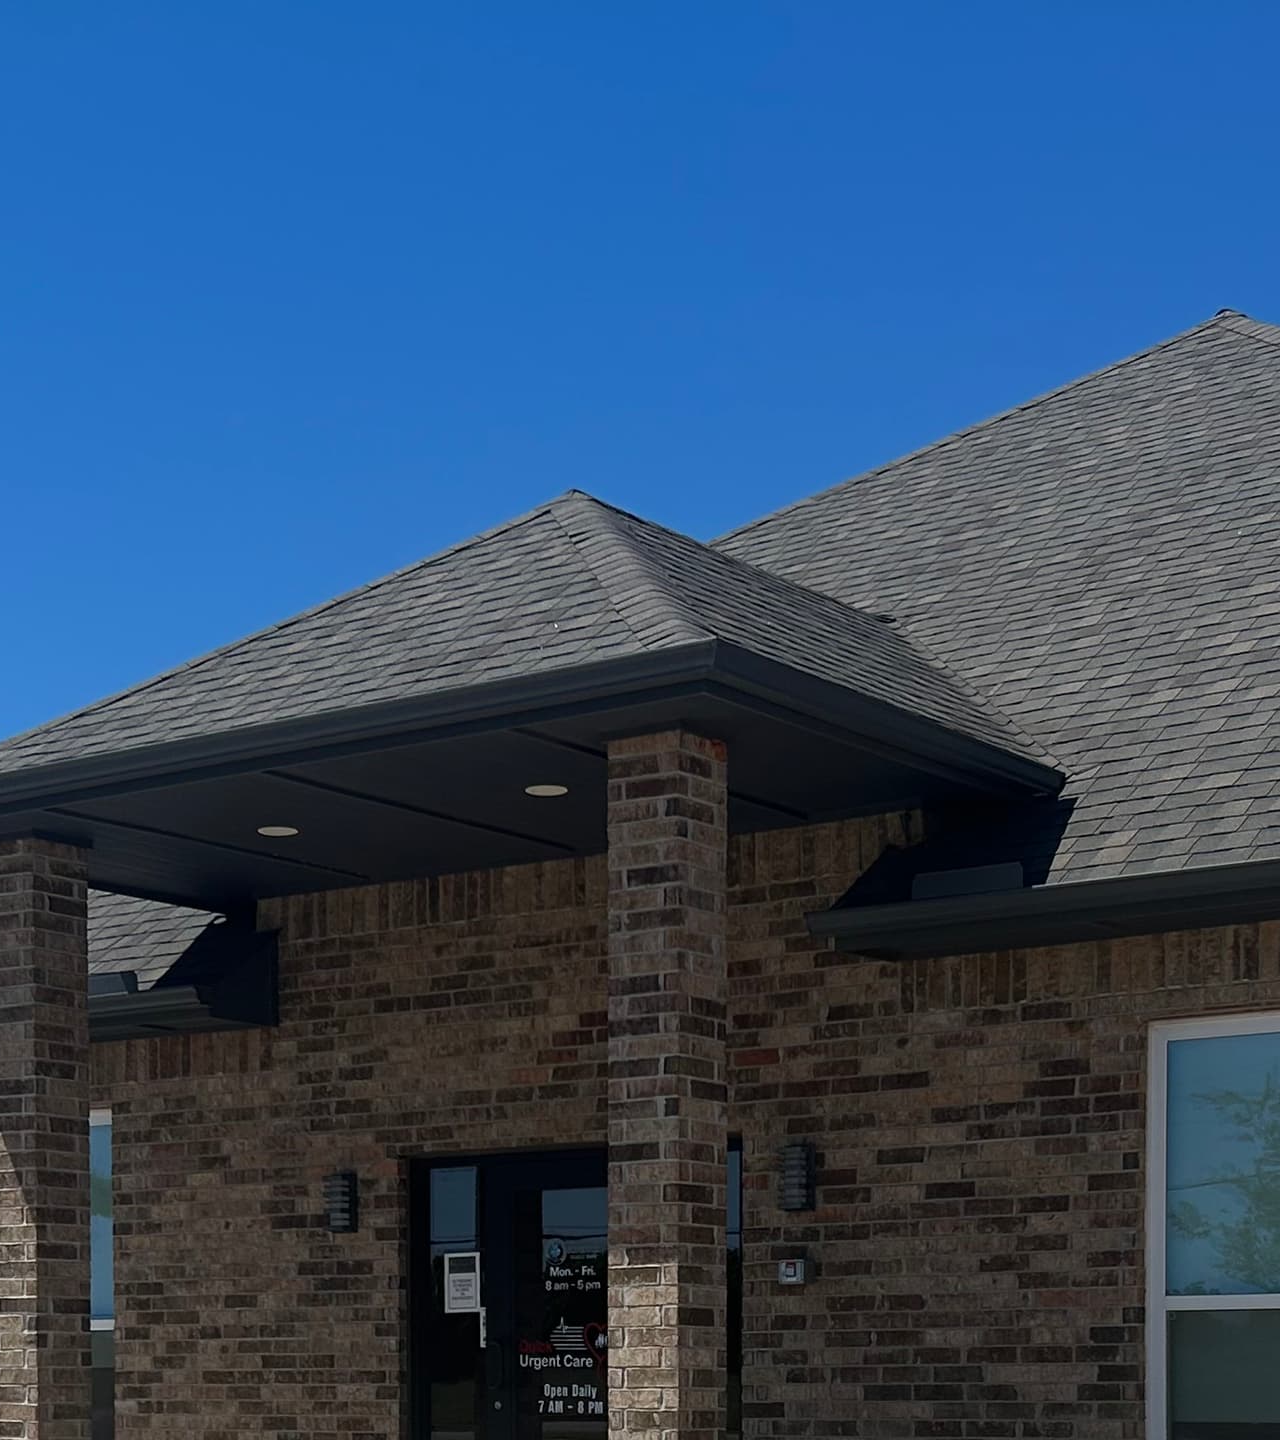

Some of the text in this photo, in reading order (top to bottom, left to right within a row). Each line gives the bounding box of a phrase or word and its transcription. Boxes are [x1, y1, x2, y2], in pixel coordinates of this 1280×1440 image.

[550, 1266, 573, 1277] Mon.
[582, 1265, 597, 1276] Fri.
[545, 1280, 552, 1291] 8
[553, 1282, 569, 1290] am
[577, 1280, 584, 1290] 5
[585, 1281, 601, 1292] pm
[519, 1354, 593, 1370] Urgent Care
[544, 1383, 597, 1399] Open Daily
[538, 1400, 545, 1413] 7
[548, 1400, 564, 1414] AM
[577, 1400, 585, 1414] 8
[588, 1401, 604, 1414] PM
